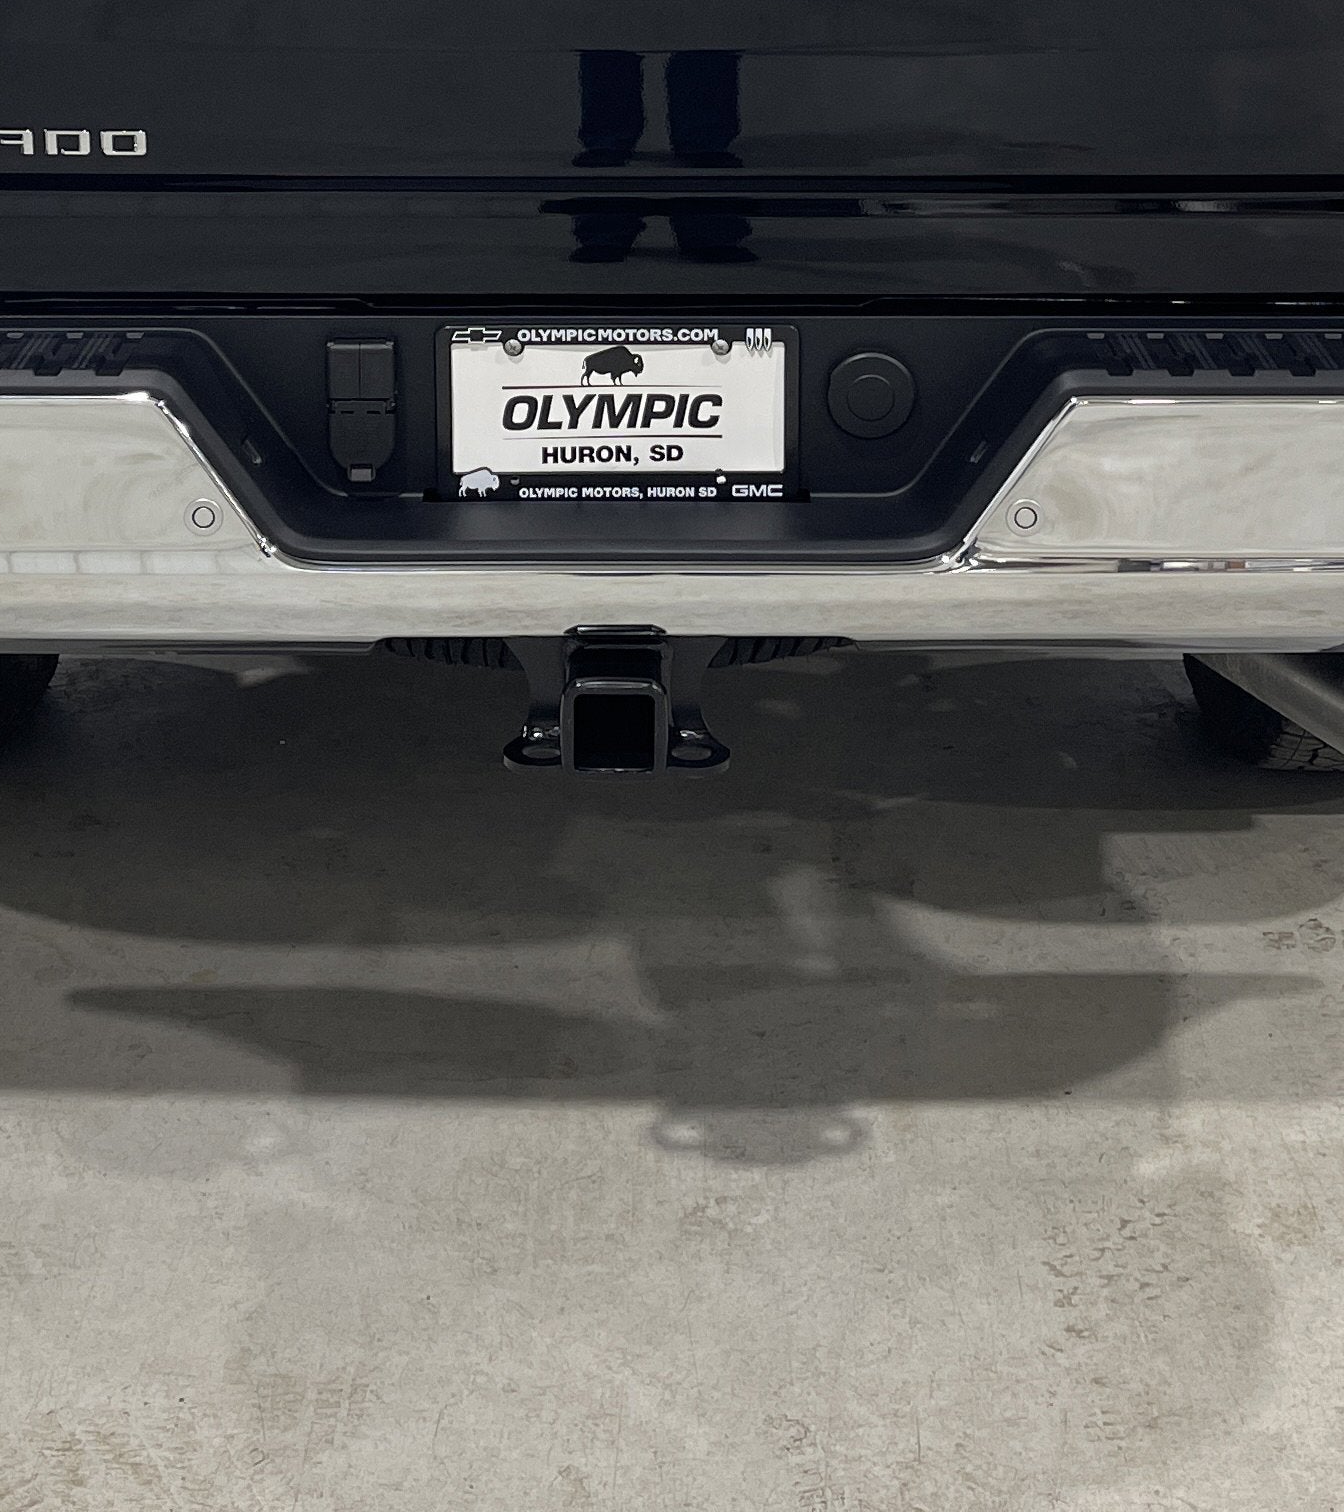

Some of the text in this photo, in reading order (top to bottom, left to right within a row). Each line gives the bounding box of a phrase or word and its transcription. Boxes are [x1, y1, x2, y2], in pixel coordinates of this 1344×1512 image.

[517, 328, 719, 343] OLYMPICMOTORS.COM
[502, 393, 723, 430] OLYMPIC
[542, 444, 684, 466] HURON, SD
[519, 487, 718, 499] OLYMPIC MOTORS, HURON SD
[731, 484, 784, 497] GMC
